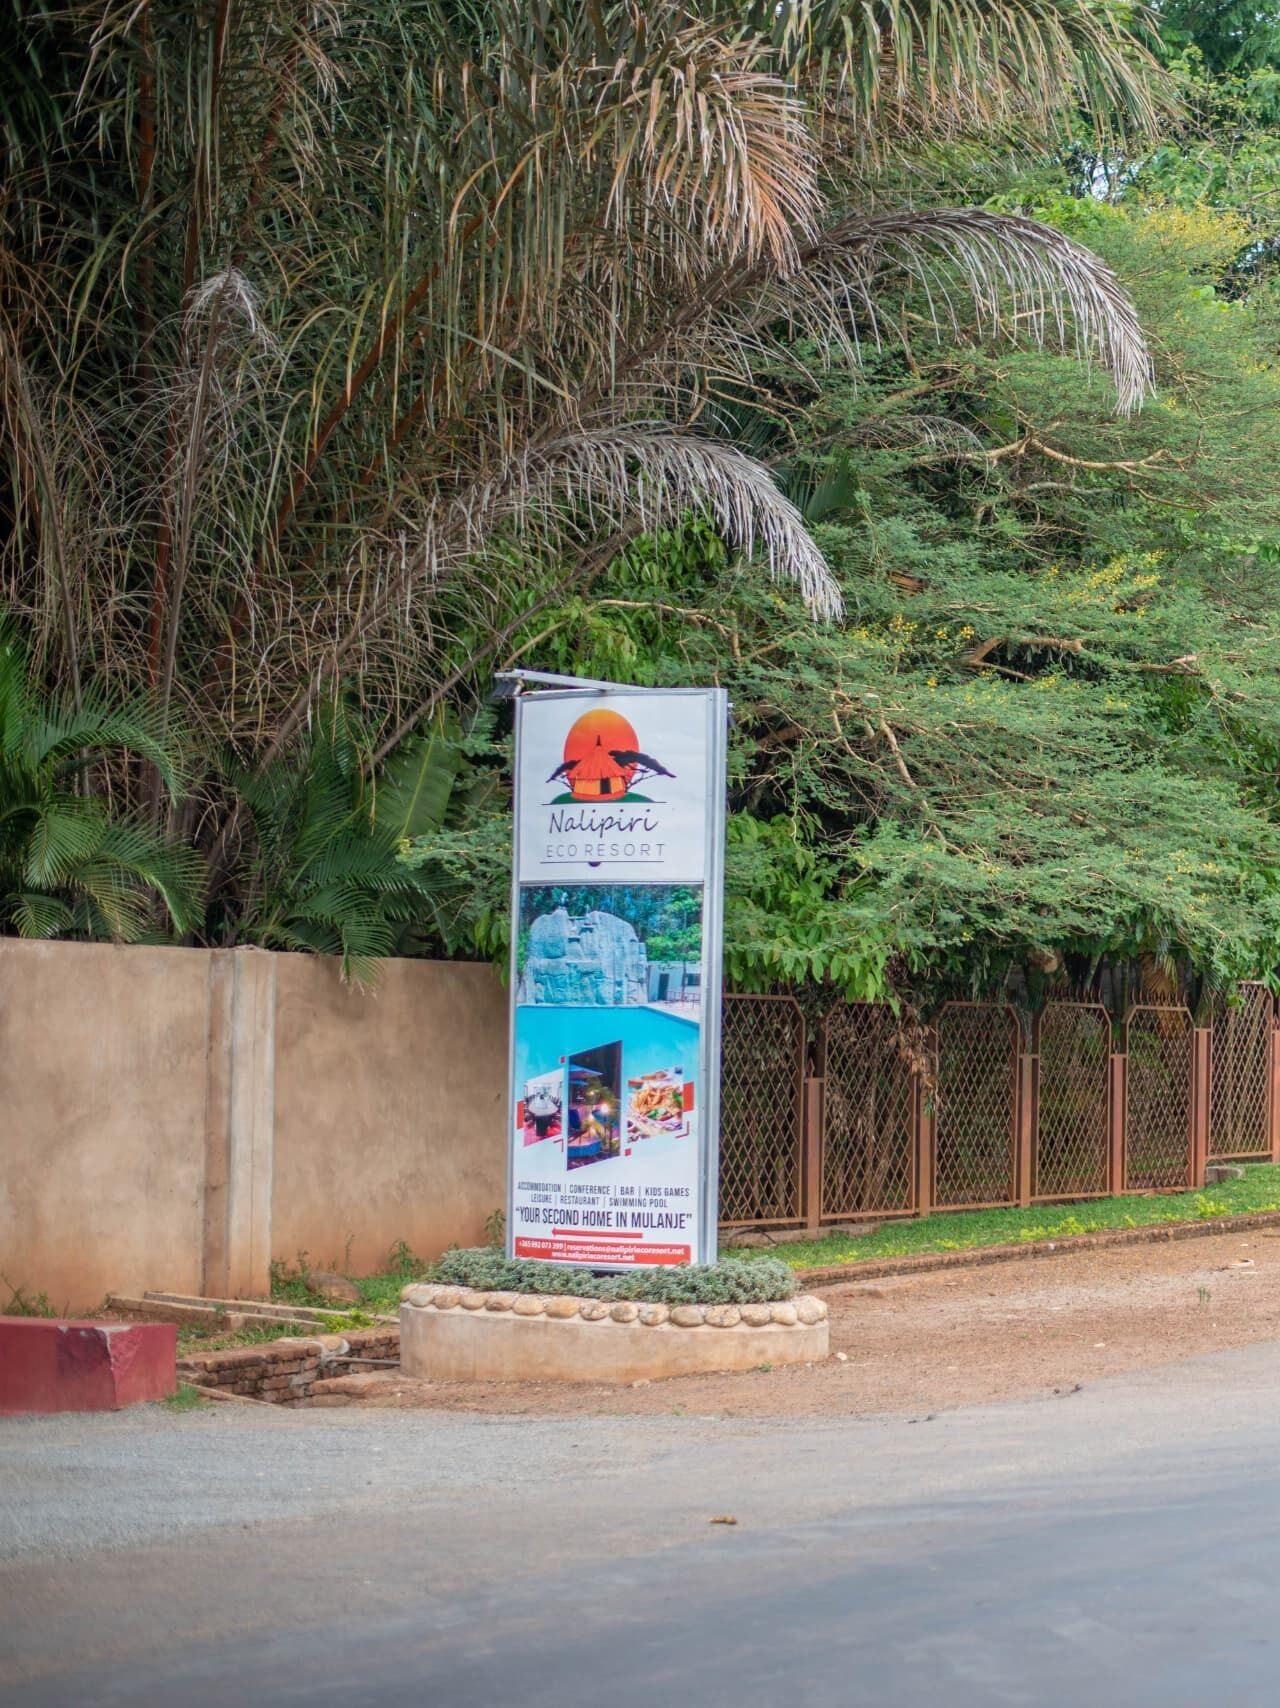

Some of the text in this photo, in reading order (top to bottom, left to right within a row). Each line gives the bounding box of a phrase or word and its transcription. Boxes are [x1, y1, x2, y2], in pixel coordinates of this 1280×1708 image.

[549, 809, 659, 838] Nalipiri
[546, 843, 664, 857] ECO RESORT
[518, 1181, 690, 1197] ACCOMMODATION CONFERENCE BAR KIDS GAMES
[531, 1193, 668, 1208] LEISURE RESTAURANT SWIMMING POOL
[542, 1208, 580, 1226] SECOND
[582, 1210, 613, 1227] HOME
[616, 1211, 628, 1228] IN
